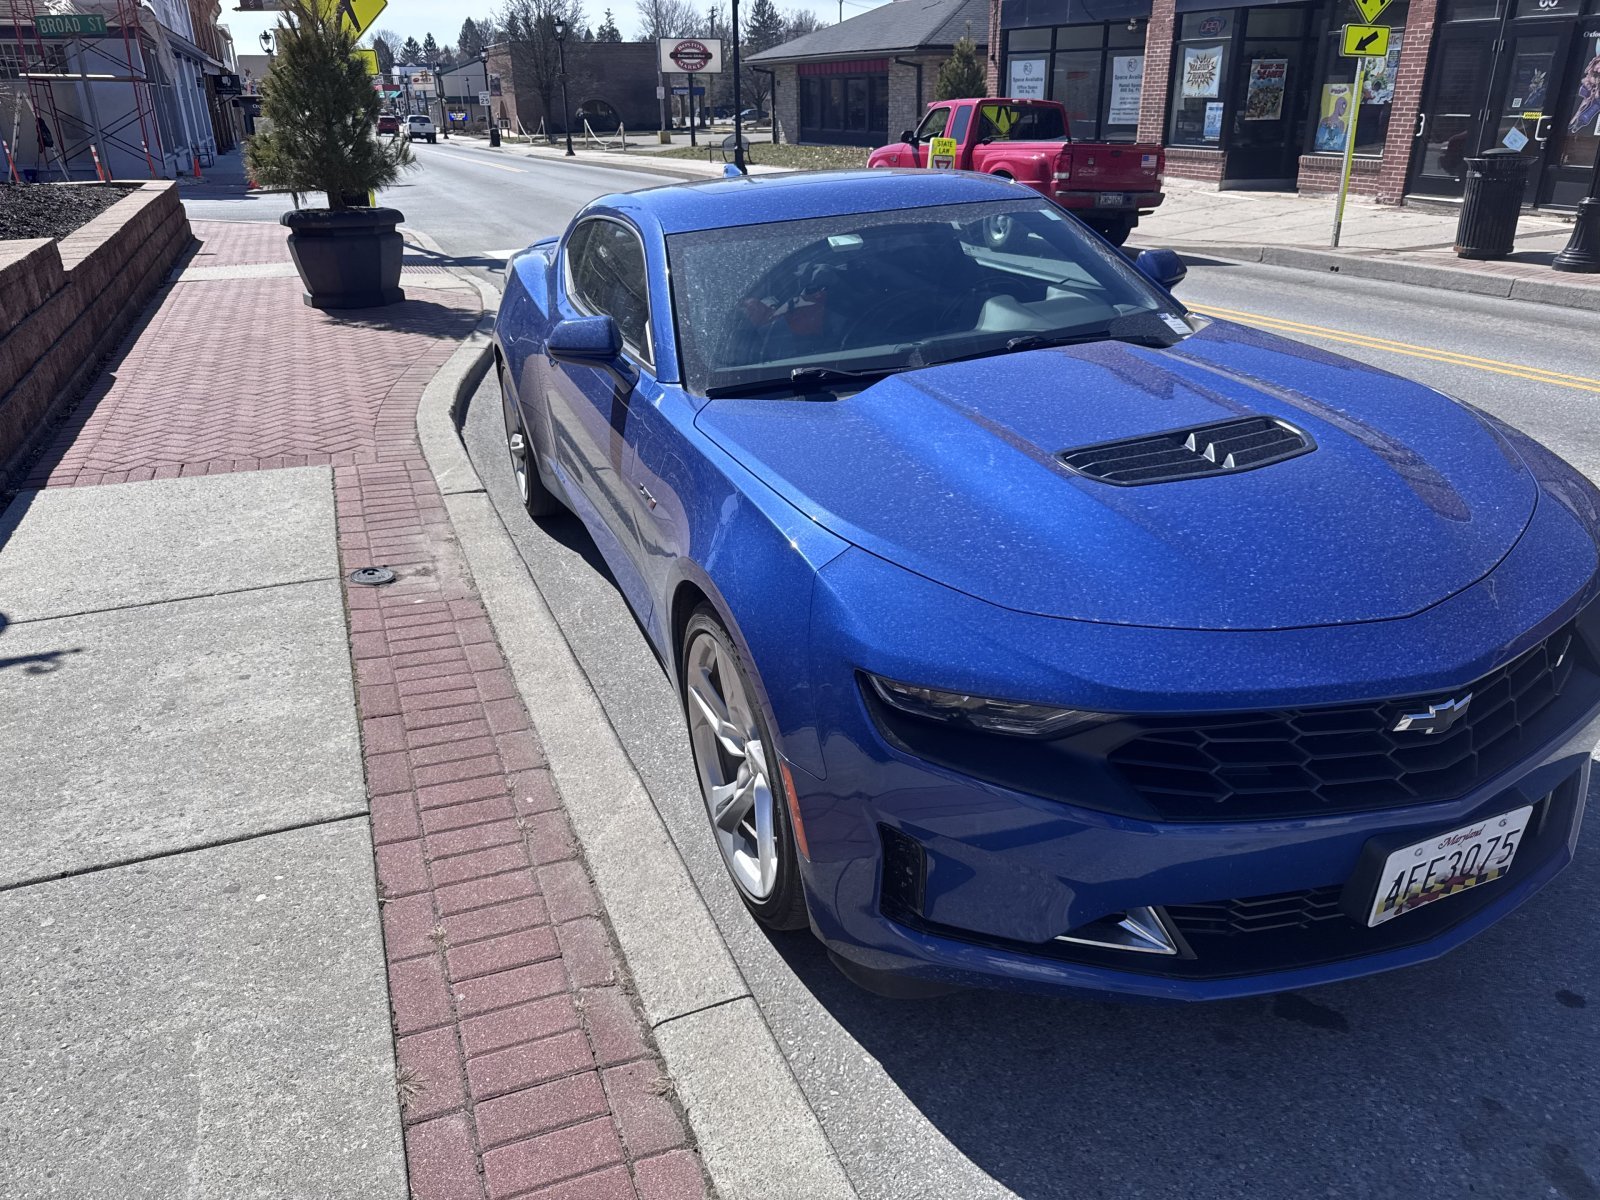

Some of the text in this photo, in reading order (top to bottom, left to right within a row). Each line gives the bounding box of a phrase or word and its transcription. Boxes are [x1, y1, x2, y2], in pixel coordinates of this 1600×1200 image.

[39, 16, 103, 33] BROAD ST
[1201, 21, 1222, 32] OPEN
[678, 42, 704, 51] BOSTON
[678, 61, 704, 69] MARKET
[1438, 825, 1486, 850] Maryland
